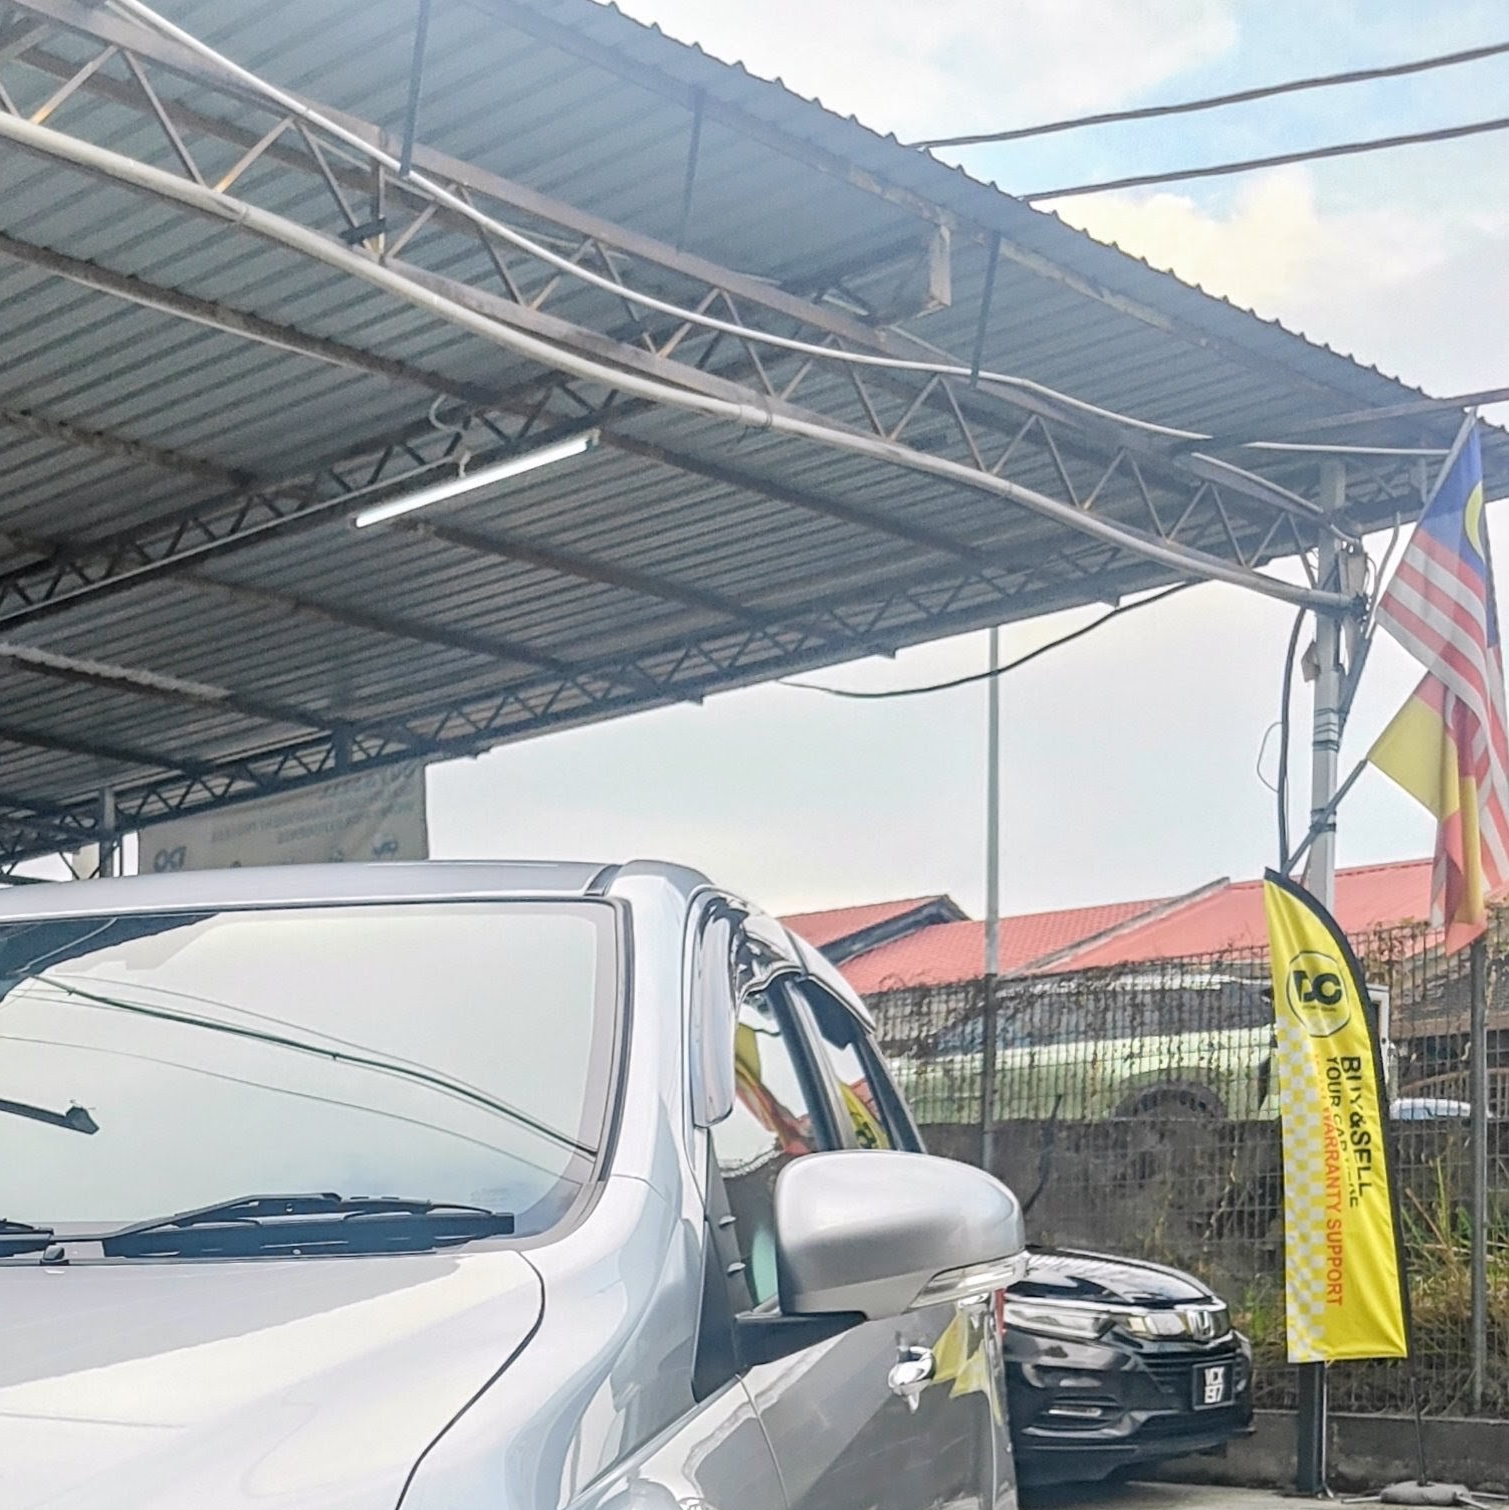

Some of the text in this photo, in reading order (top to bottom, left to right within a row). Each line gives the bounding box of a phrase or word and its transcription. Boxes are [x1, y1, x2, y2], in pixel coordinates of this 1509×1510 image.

[1326, 1056, 1341, 1107] YOUR
[1322, 1107, 1343, 1306] WARRANTY SUPPORT
